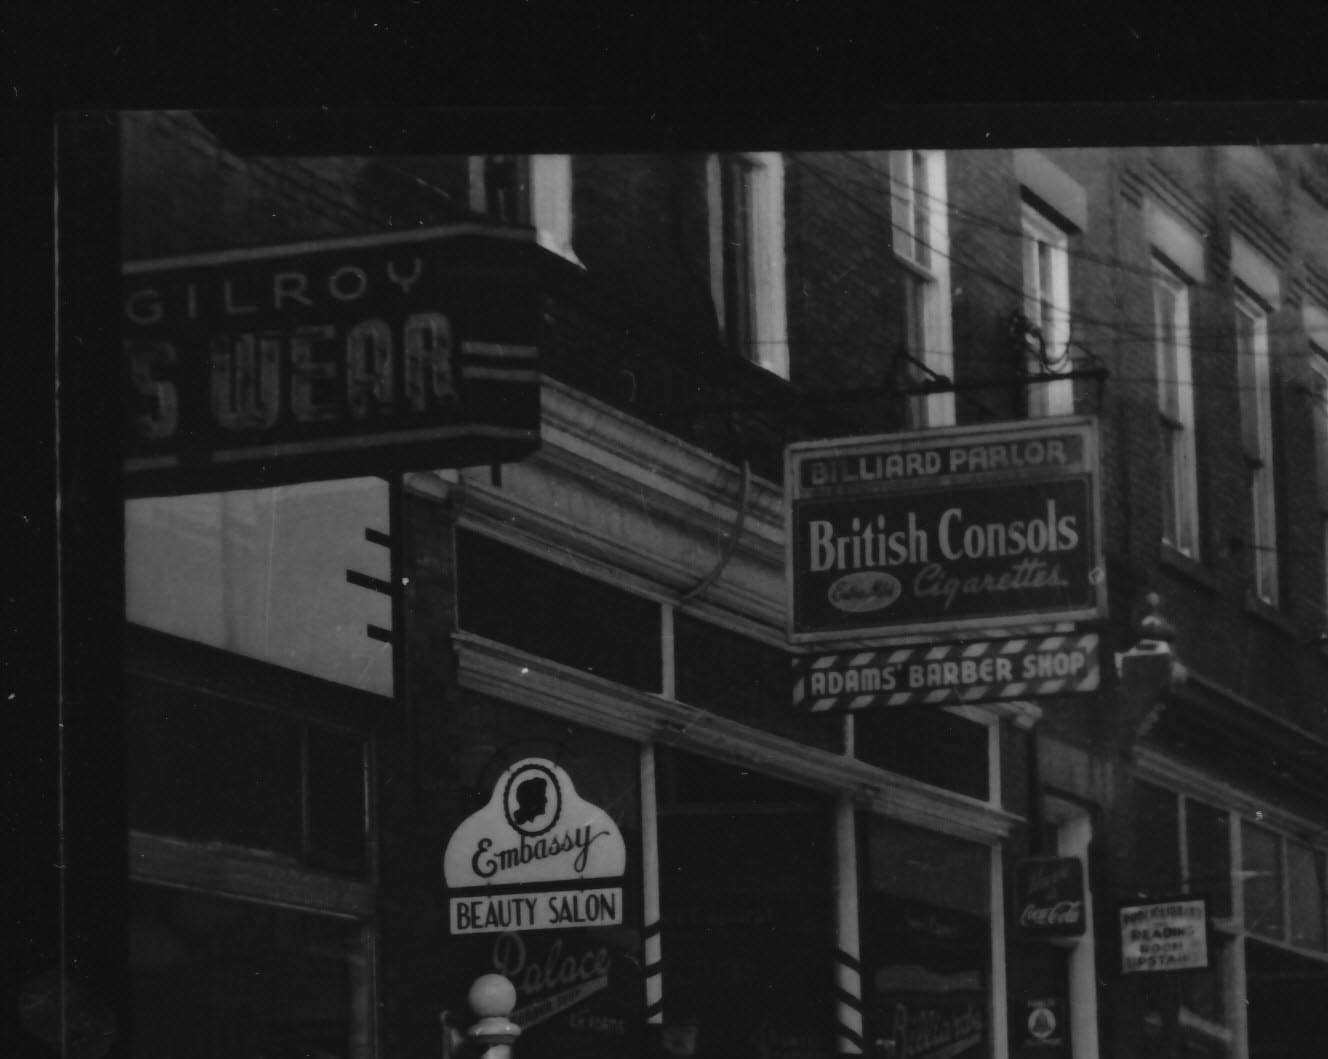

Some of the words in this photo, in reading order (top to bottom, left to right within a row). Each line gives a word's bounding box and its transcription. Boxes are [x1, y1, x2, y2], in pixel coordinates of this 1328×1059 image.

[124, 256, 425, 327] GILROY
[209, 310, 461, 433] WEAR
[810, 450, 942, 486] BILLIARD
[948, 439, 1067, 472] PARLOR
[808, 510, 929, 573] British
[937, 498, 1080, 562] Consols
[811, 663, 904, 697] ADAMS'
[908, 656, 1014, 689] BARBER
[1022, 650, 1087, 679] SHOP
[471, 824, 609, 879] Embassy
[456, 897, 538, 930] BEAUTY
[549, 892, 616, 924] SALON
[492, 930, 611, 997] Palace
